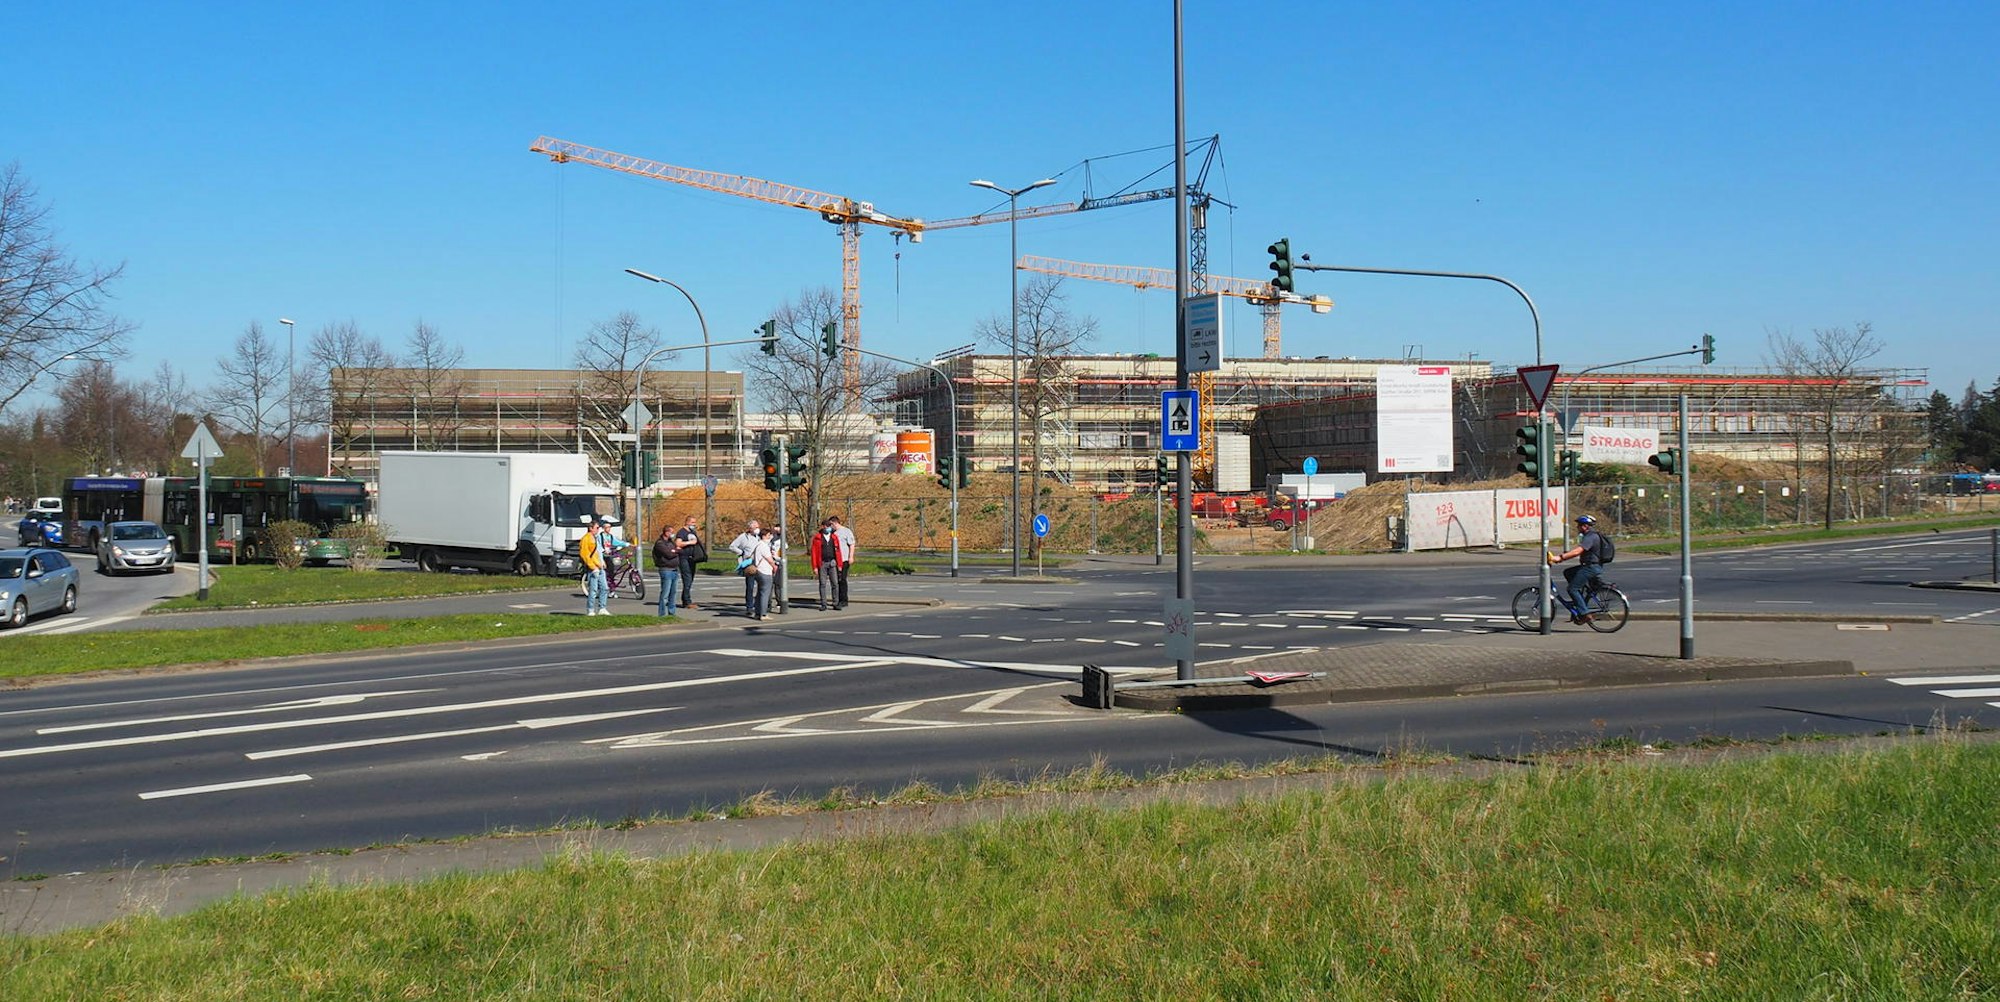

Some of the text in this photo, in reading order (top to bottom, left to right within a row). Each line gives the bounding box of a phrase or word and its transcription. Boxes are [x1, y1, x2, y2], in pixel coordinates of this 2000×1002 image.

[1589, 436, 1653, 448] STRABAG
[900, 452, 927, 463] MEGA
[1504, 498, 1558, 518] ZÜBLN
